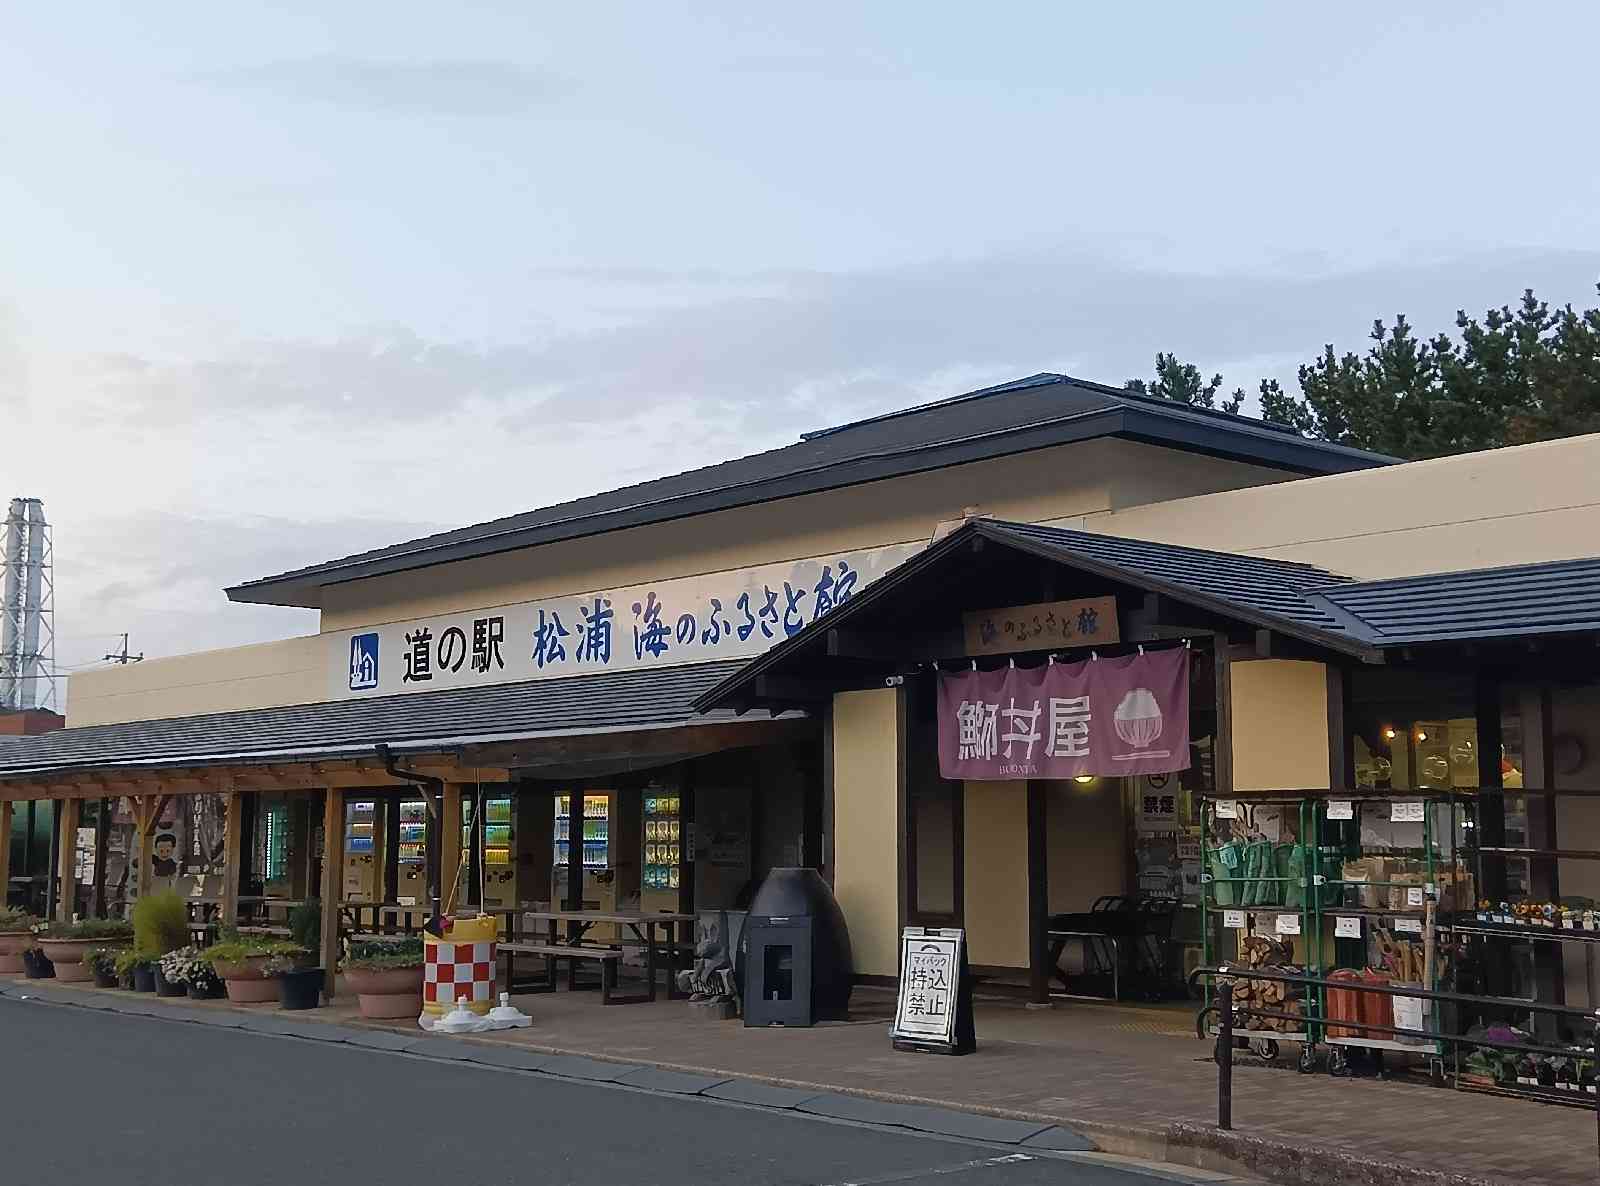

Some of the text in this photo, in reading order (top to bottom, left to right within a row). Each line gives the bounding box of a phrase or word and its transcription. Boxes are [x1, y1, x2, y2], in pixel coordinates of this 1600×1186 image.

[403, 560, 858, 683] 道の駅 松浦 海のふるさと館
[956, 696, 1092, 760] 鰤丼屋
[910, 966, 948, 991] 持込
[908, 993, 945, 1016] 禁止
